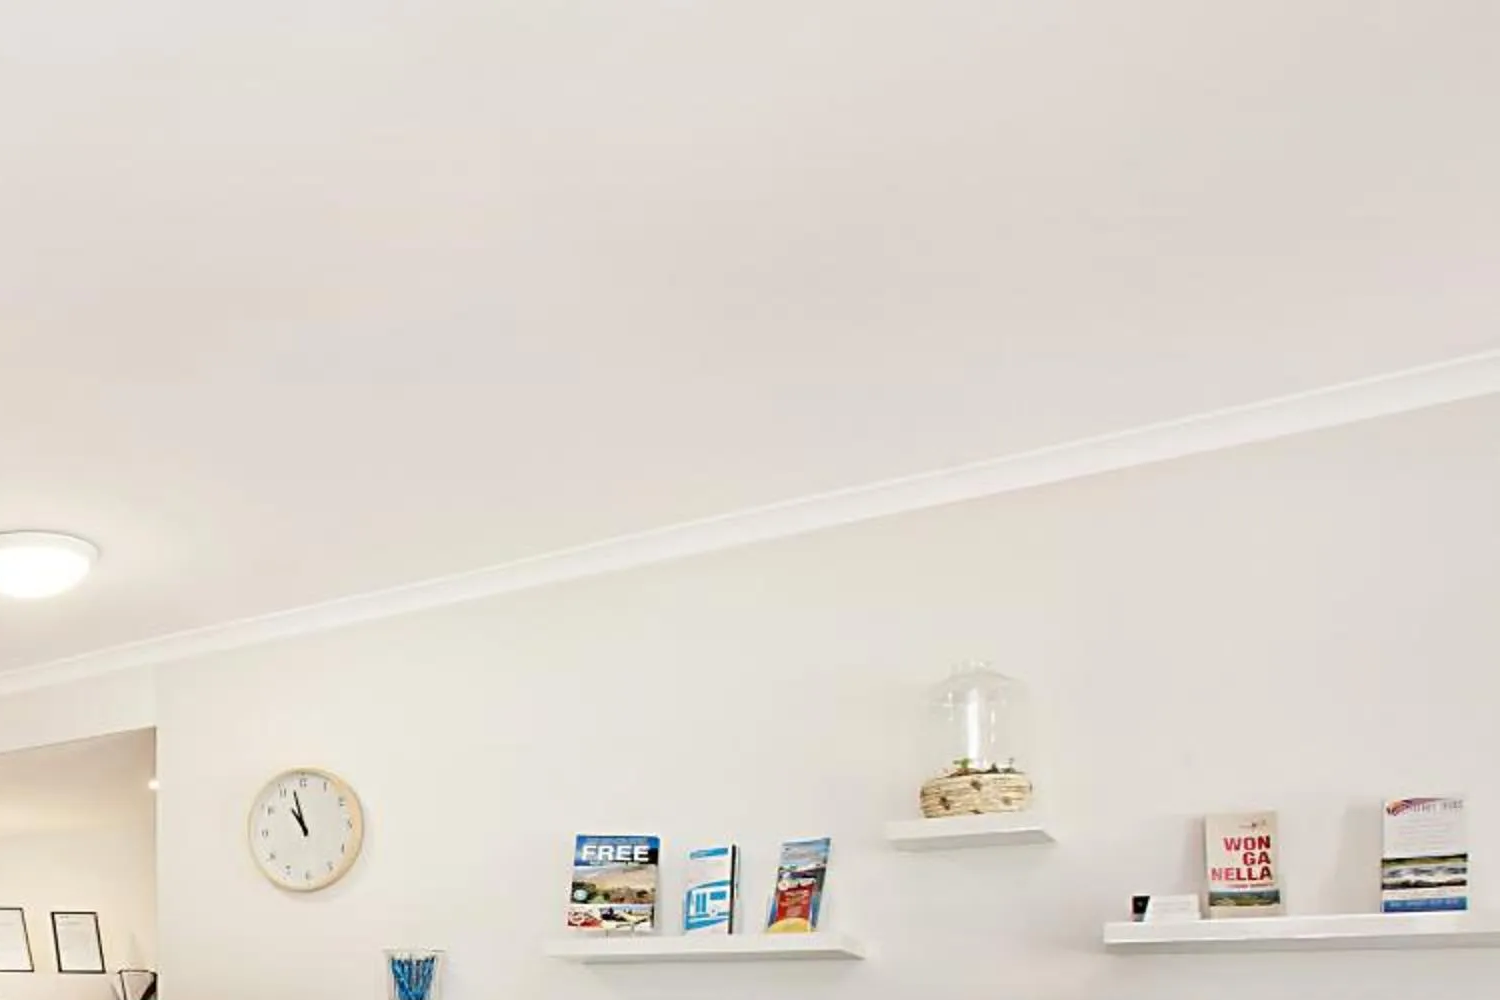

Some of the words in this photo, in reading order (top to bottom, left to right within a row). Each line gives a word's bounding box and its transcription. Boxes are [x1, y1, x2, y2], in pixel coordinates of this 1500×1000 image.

[1223, 835, 1271, 851] WON
[580, 844, 650, 862] FREE
[1243, 851, 1271, 866] GA
[1211, 866, 1273, 881] NELLA
